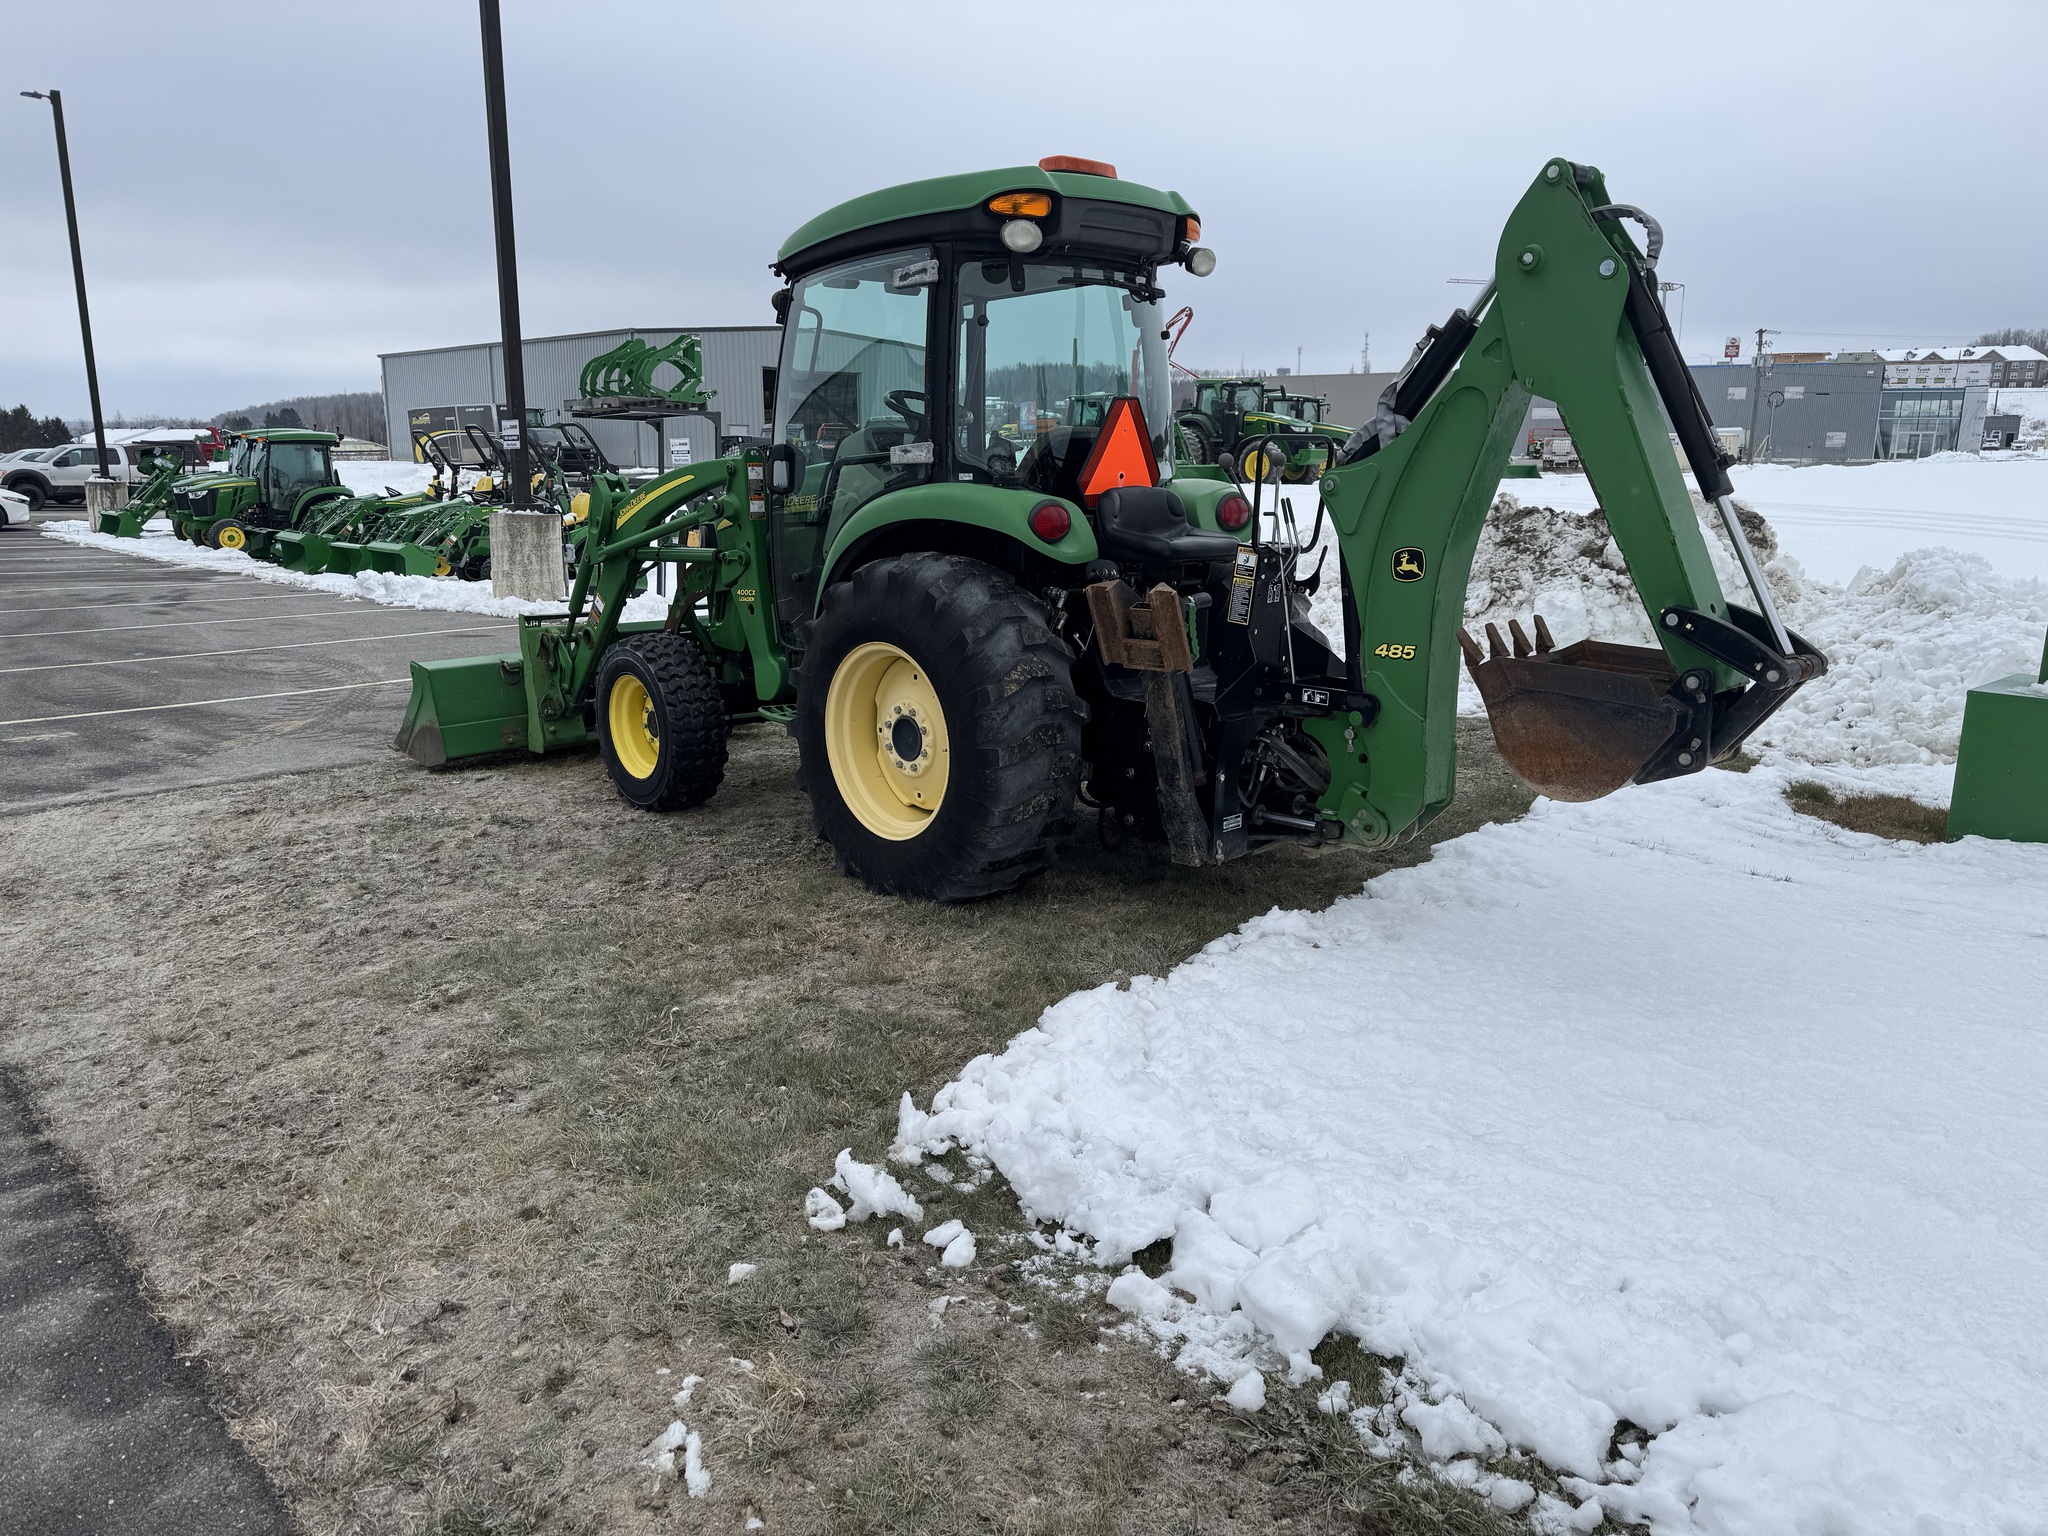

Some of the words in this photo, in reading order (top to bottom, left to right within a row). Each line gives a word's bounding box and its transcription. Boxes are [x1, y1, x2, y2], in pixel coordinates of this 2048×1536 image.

[619, 503, 631, 519] JOHN
[630, 491, 648, 510] DEERE
[786, 494, 817, 506] DEERE
[1374, 643, 1417, 660] 485
